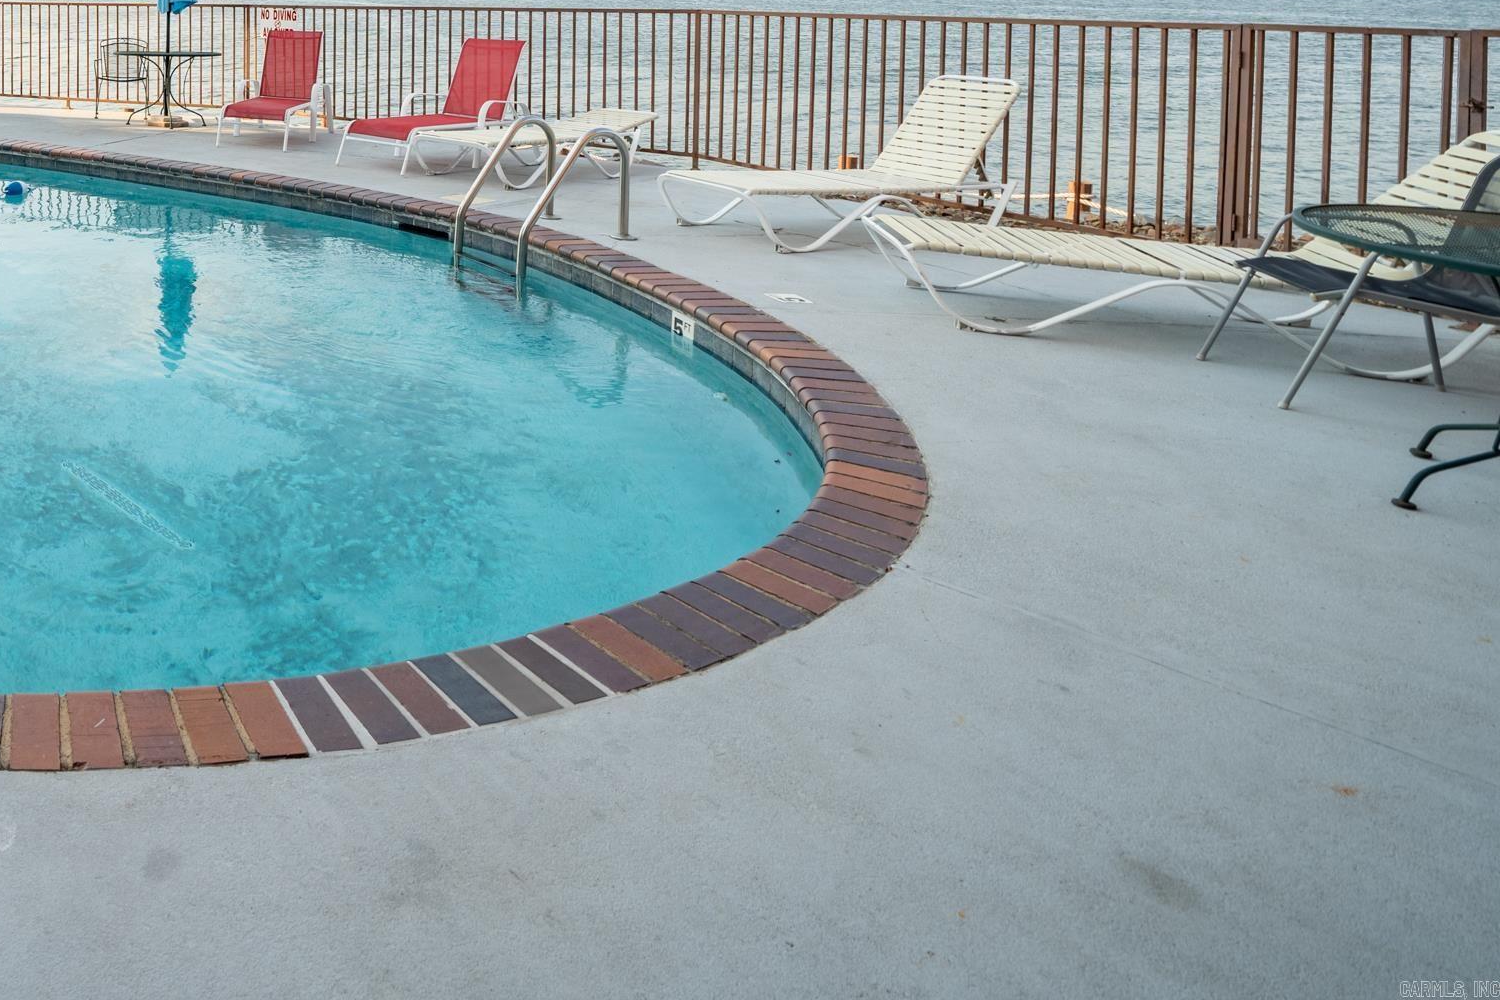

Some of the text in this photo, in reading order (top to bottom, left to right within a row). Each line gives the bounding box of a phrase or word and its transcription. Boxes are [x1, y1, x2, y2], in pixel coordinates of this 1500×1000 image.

[261, 10, 297, 21] NO DIVING
[674, 316, 683, 336] 5
